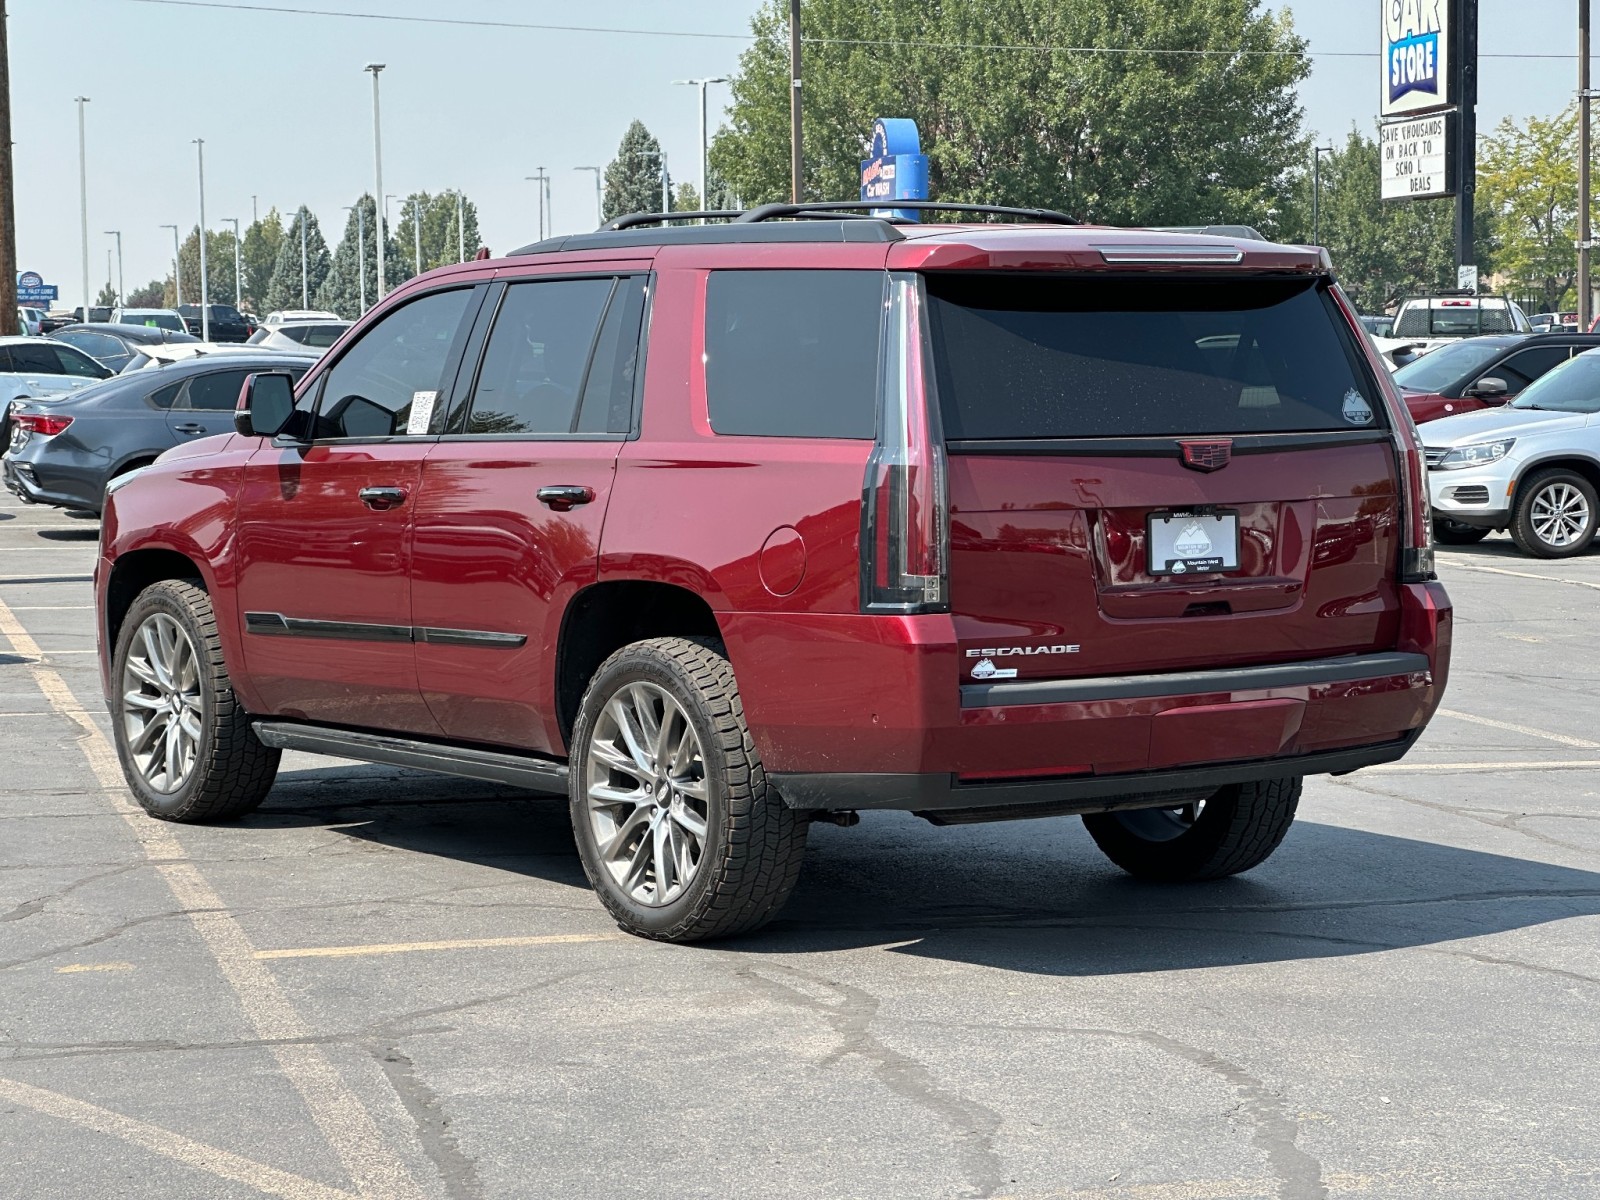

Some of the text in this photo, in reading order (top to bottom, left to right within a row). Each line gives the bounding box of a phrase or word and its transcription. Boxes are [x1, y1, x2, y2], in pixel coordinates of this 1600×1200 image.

[1386, 0, 1441, 44] CAR
[1392, 40, 1434, 87] STORE
[1382, 120, 1442, 143] SAVE THOUSANDS
[1386, 140, 1432, 160] ON BACK TO
[1410, 176, 1431, 192] DEALS
[965, 644, 1080, 658] ESCALADE
